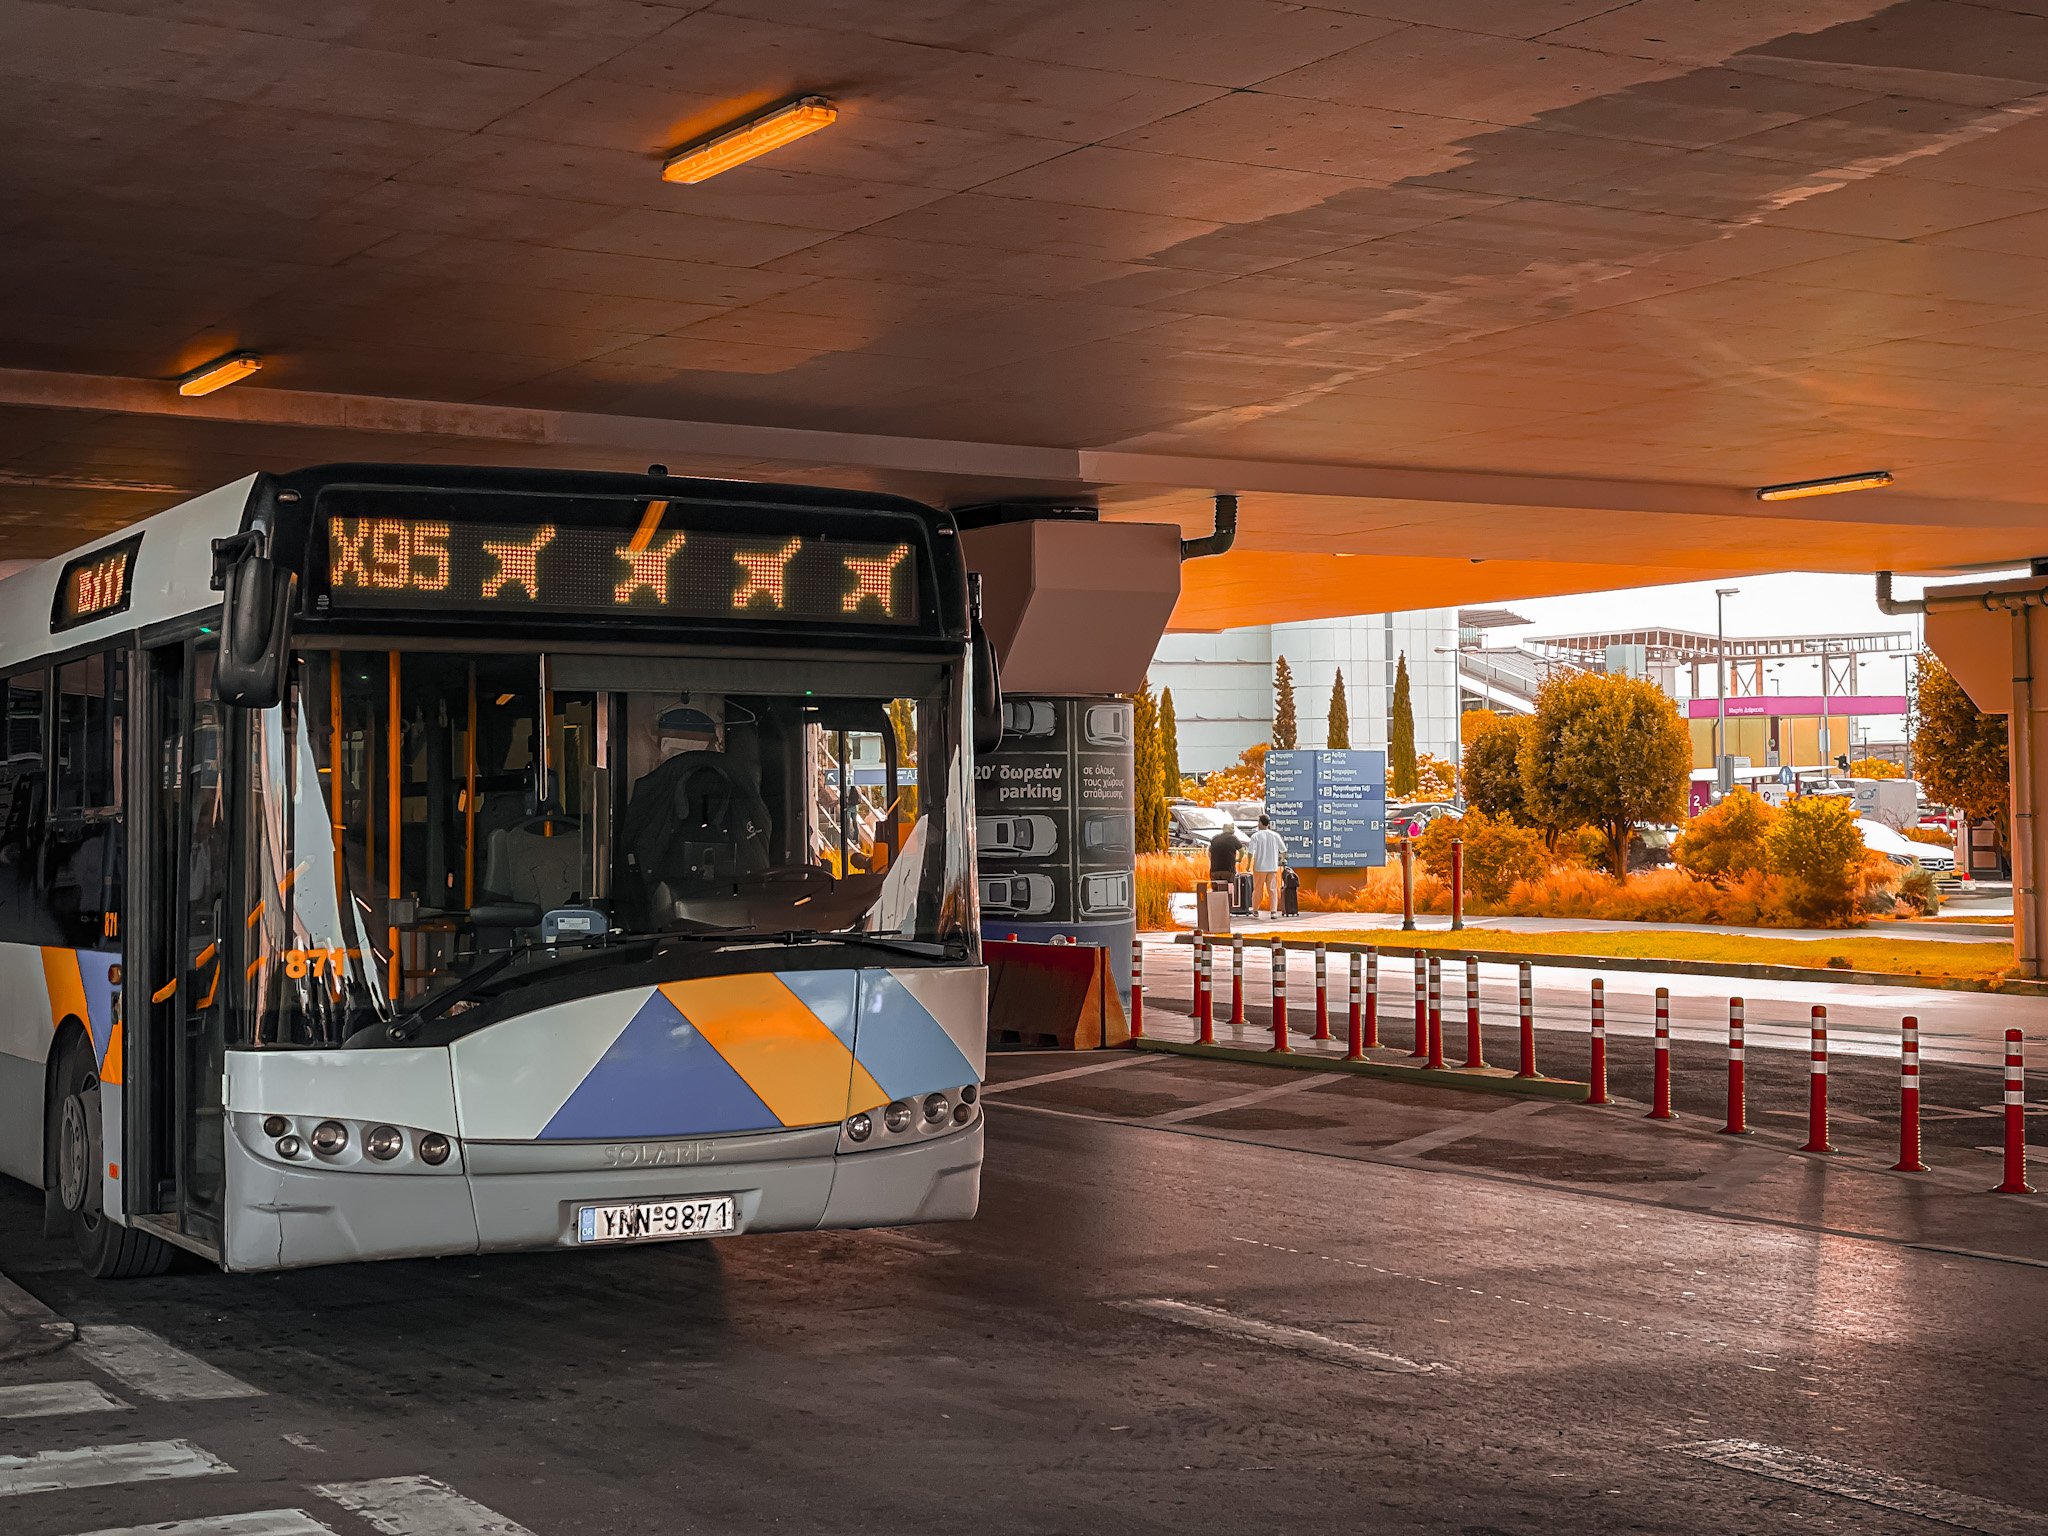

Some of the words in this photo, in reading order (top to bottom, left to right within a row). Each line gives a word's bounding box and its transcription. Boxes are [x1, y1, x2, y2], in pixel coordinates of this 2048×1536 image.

[331, 515, 450, 591] X95
[1000, 764, 1062, 782] δωρεάν
[1083, 768, 1094, 776] σε
[1095, 764, 1115, 777] όλους
[1084, 778, 1102, 788] τους
[1102, 777, 1125, 789] χώρους
[1000, 784, 1062, 802] parking
[1084, 788, 1124, 800] στάθμευσης
[1694, 796, 1700, 806] 2
[104, 912, 118, 938] 871
[286, 946, 344, 978] 871
[604, 1142, 716, 1167] SOLARIS
